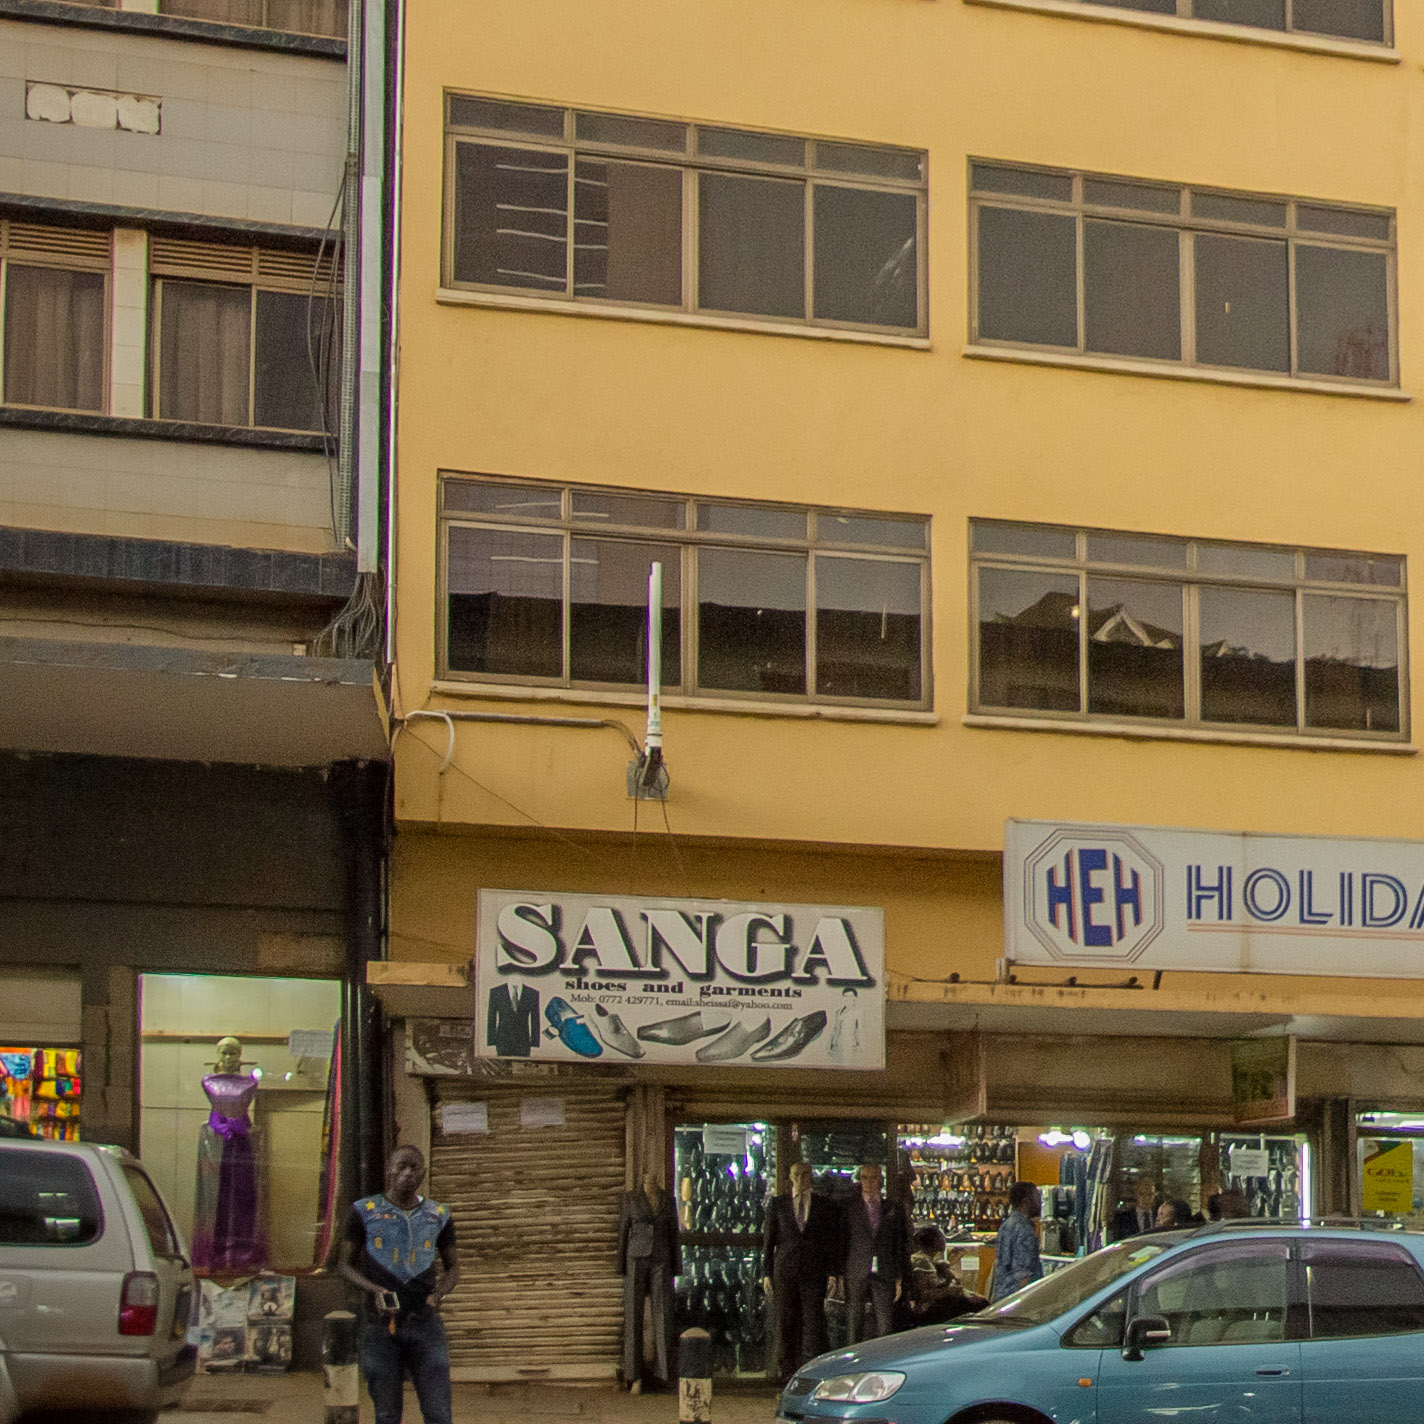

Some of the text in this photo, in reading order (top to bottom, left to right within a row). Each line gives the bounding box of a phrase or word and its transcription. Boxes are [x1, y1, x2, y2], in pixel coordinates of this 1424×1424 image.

[1046, 847, 1143, 947] HEH
[496, 902, 874, 984] SANGA
[564, 977, 802, 999] shoes and garments
[570, 993, 597, 1003] Mob:
[598, 994, 624, 1004] 0772
